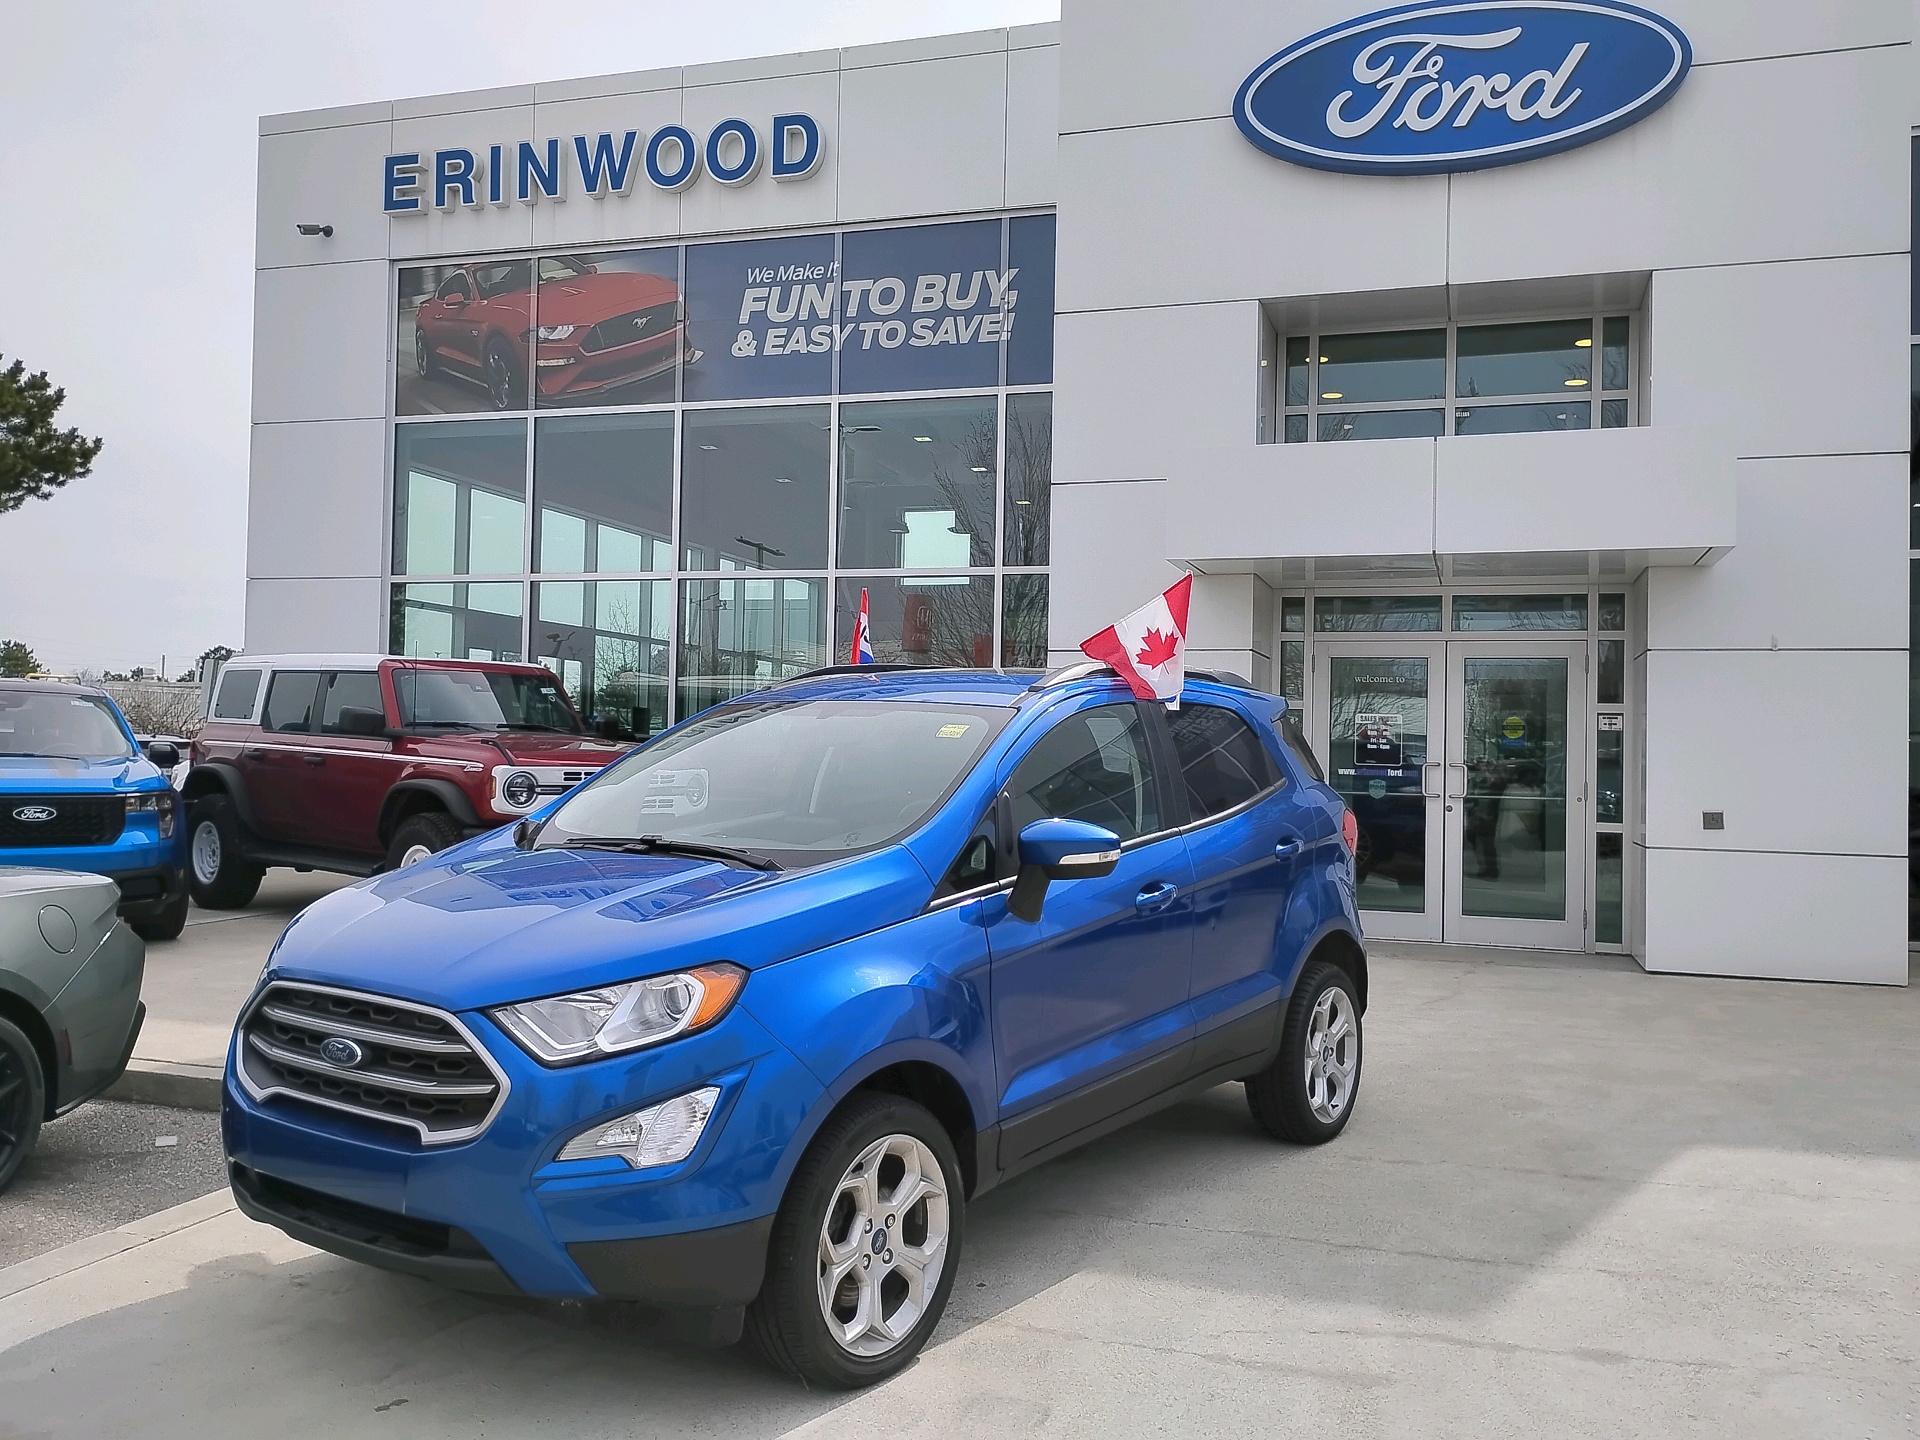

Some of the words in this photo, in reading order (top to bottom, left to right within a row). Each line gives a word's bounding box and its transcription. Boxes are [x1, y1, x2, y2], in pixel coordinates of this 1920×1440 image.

[1326, 27, 1590, 138] Ford
[383, 112, 823, 215] ERINWOOD
[747, 268, 774, 284] We
[776, 263, 825, 282] Make
[827, 260, 840, 278] It
[738, 282, 836, 325] FUN
[842, 278, 906, 317] TO
[910, 268, 1020, 313] BUY,
[731, 329, 758, 357] &
[763, 322, 856, 356] EASY
[858, 320, 907, 350] TO
[908, 312, 1016, 347] SAVE!
[1354, 674, 1394, 683] welcome
[1396, 675, 1405, 683] to
[20, 808, 49, 819] Ford
[326, 1041, 349, 1060] Ford
